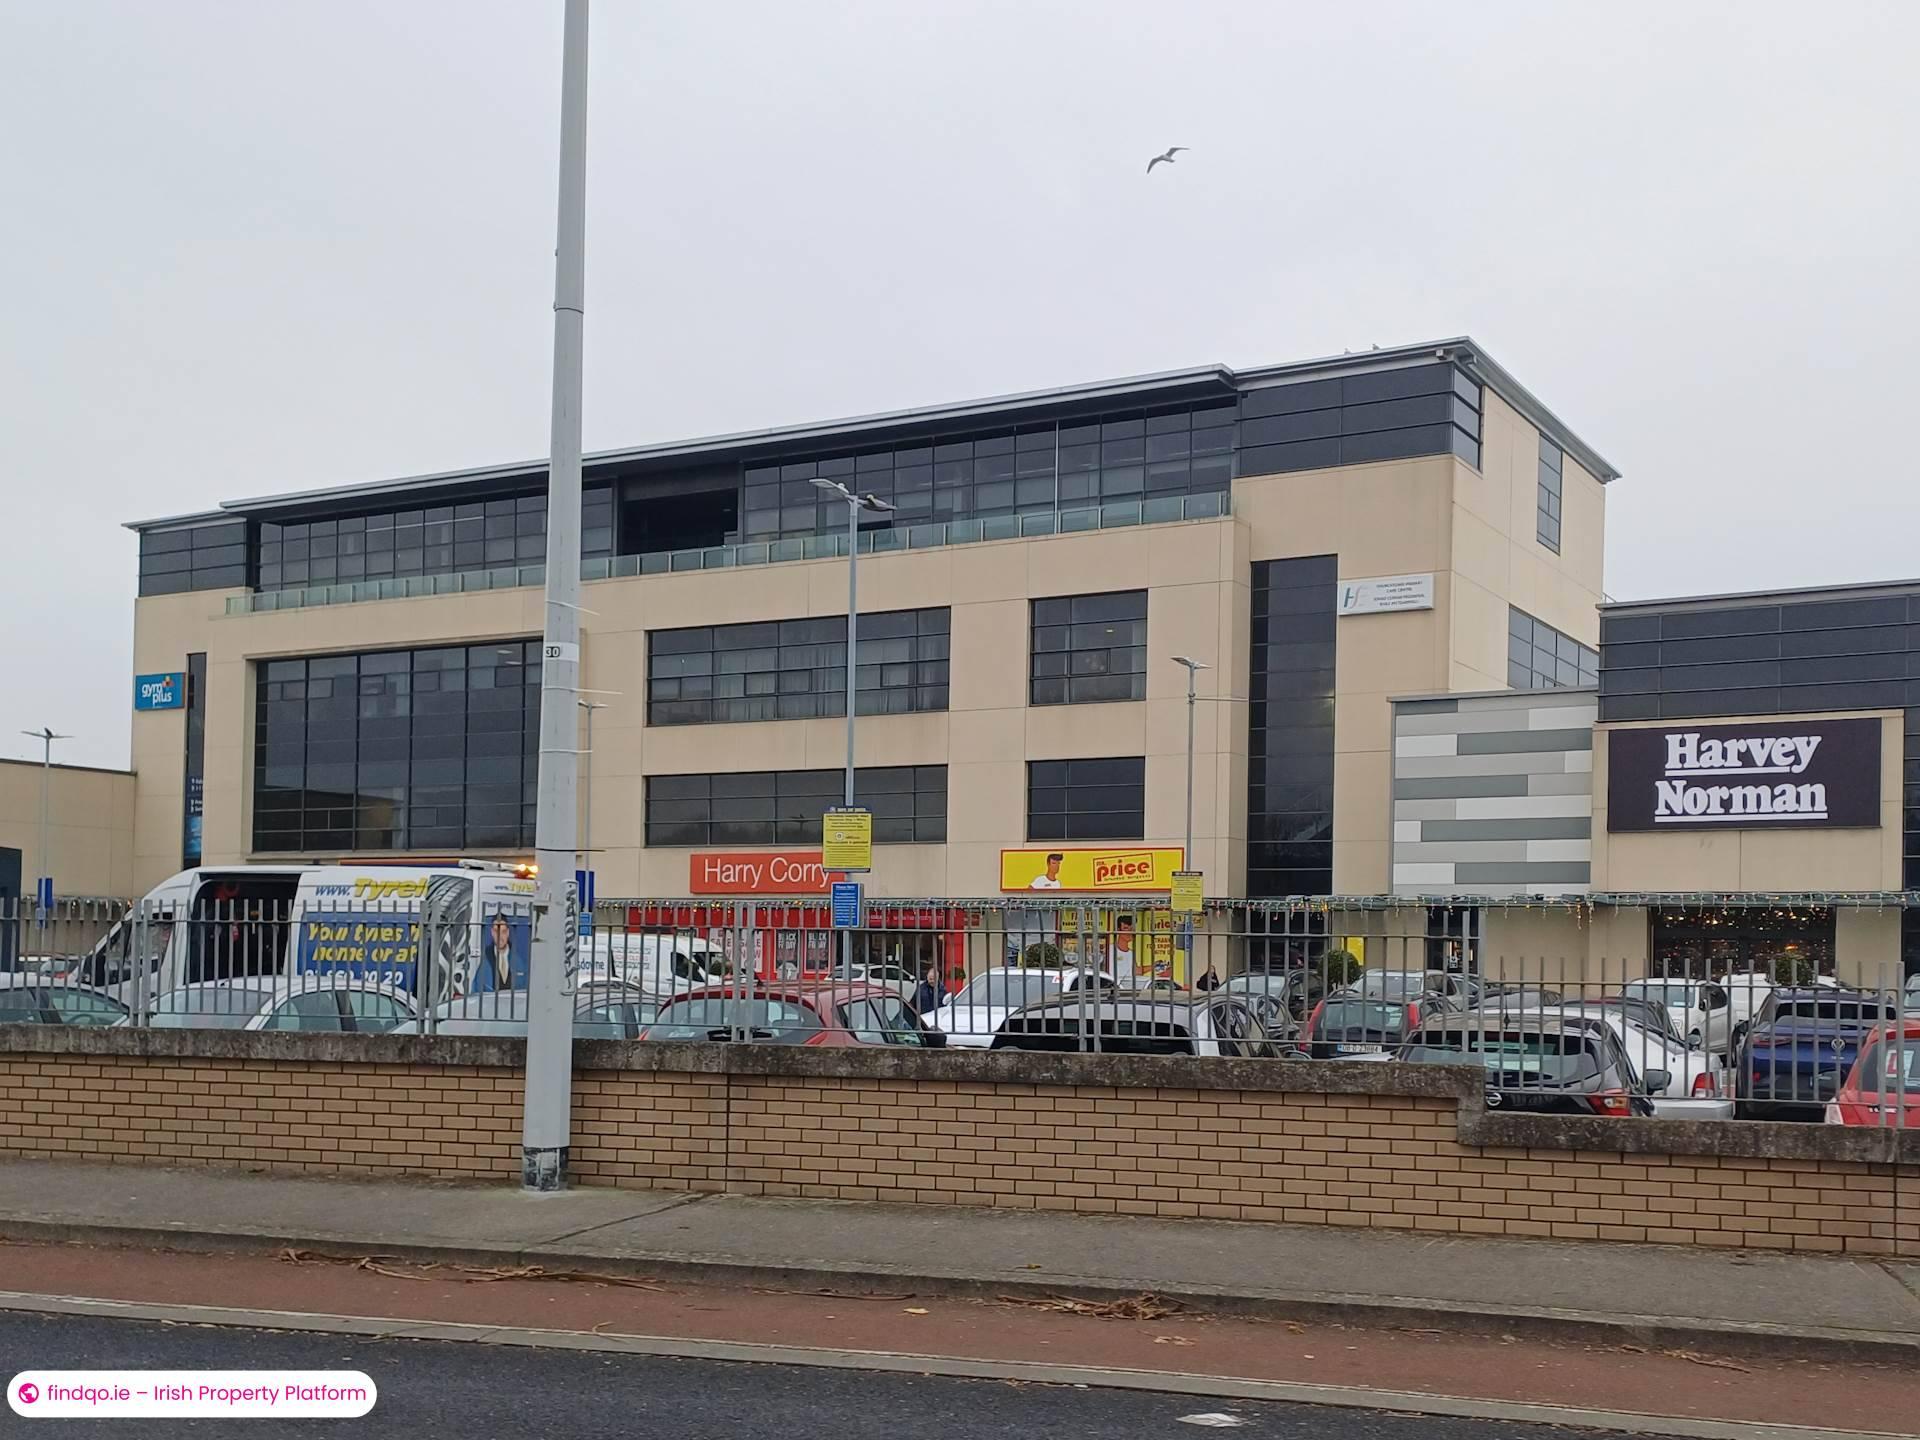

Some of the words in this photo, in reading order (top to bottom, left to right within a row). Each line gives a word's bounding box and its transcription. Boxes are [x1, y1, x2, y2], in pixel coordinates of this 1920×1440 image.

[141, 684, 162, 698] gym
[152, 691, 172, 706] plus
[1665, 733, 1822, 774] Harvey
[1655, 780, 1828, 816] Norman
[704, 858, 763, 889] Harry
[769, 857, 830, 888] Corry
[1096, 859, 1150, 882] price
[371, 948, 393, 961] or
[395, 945, 417, 963] at
